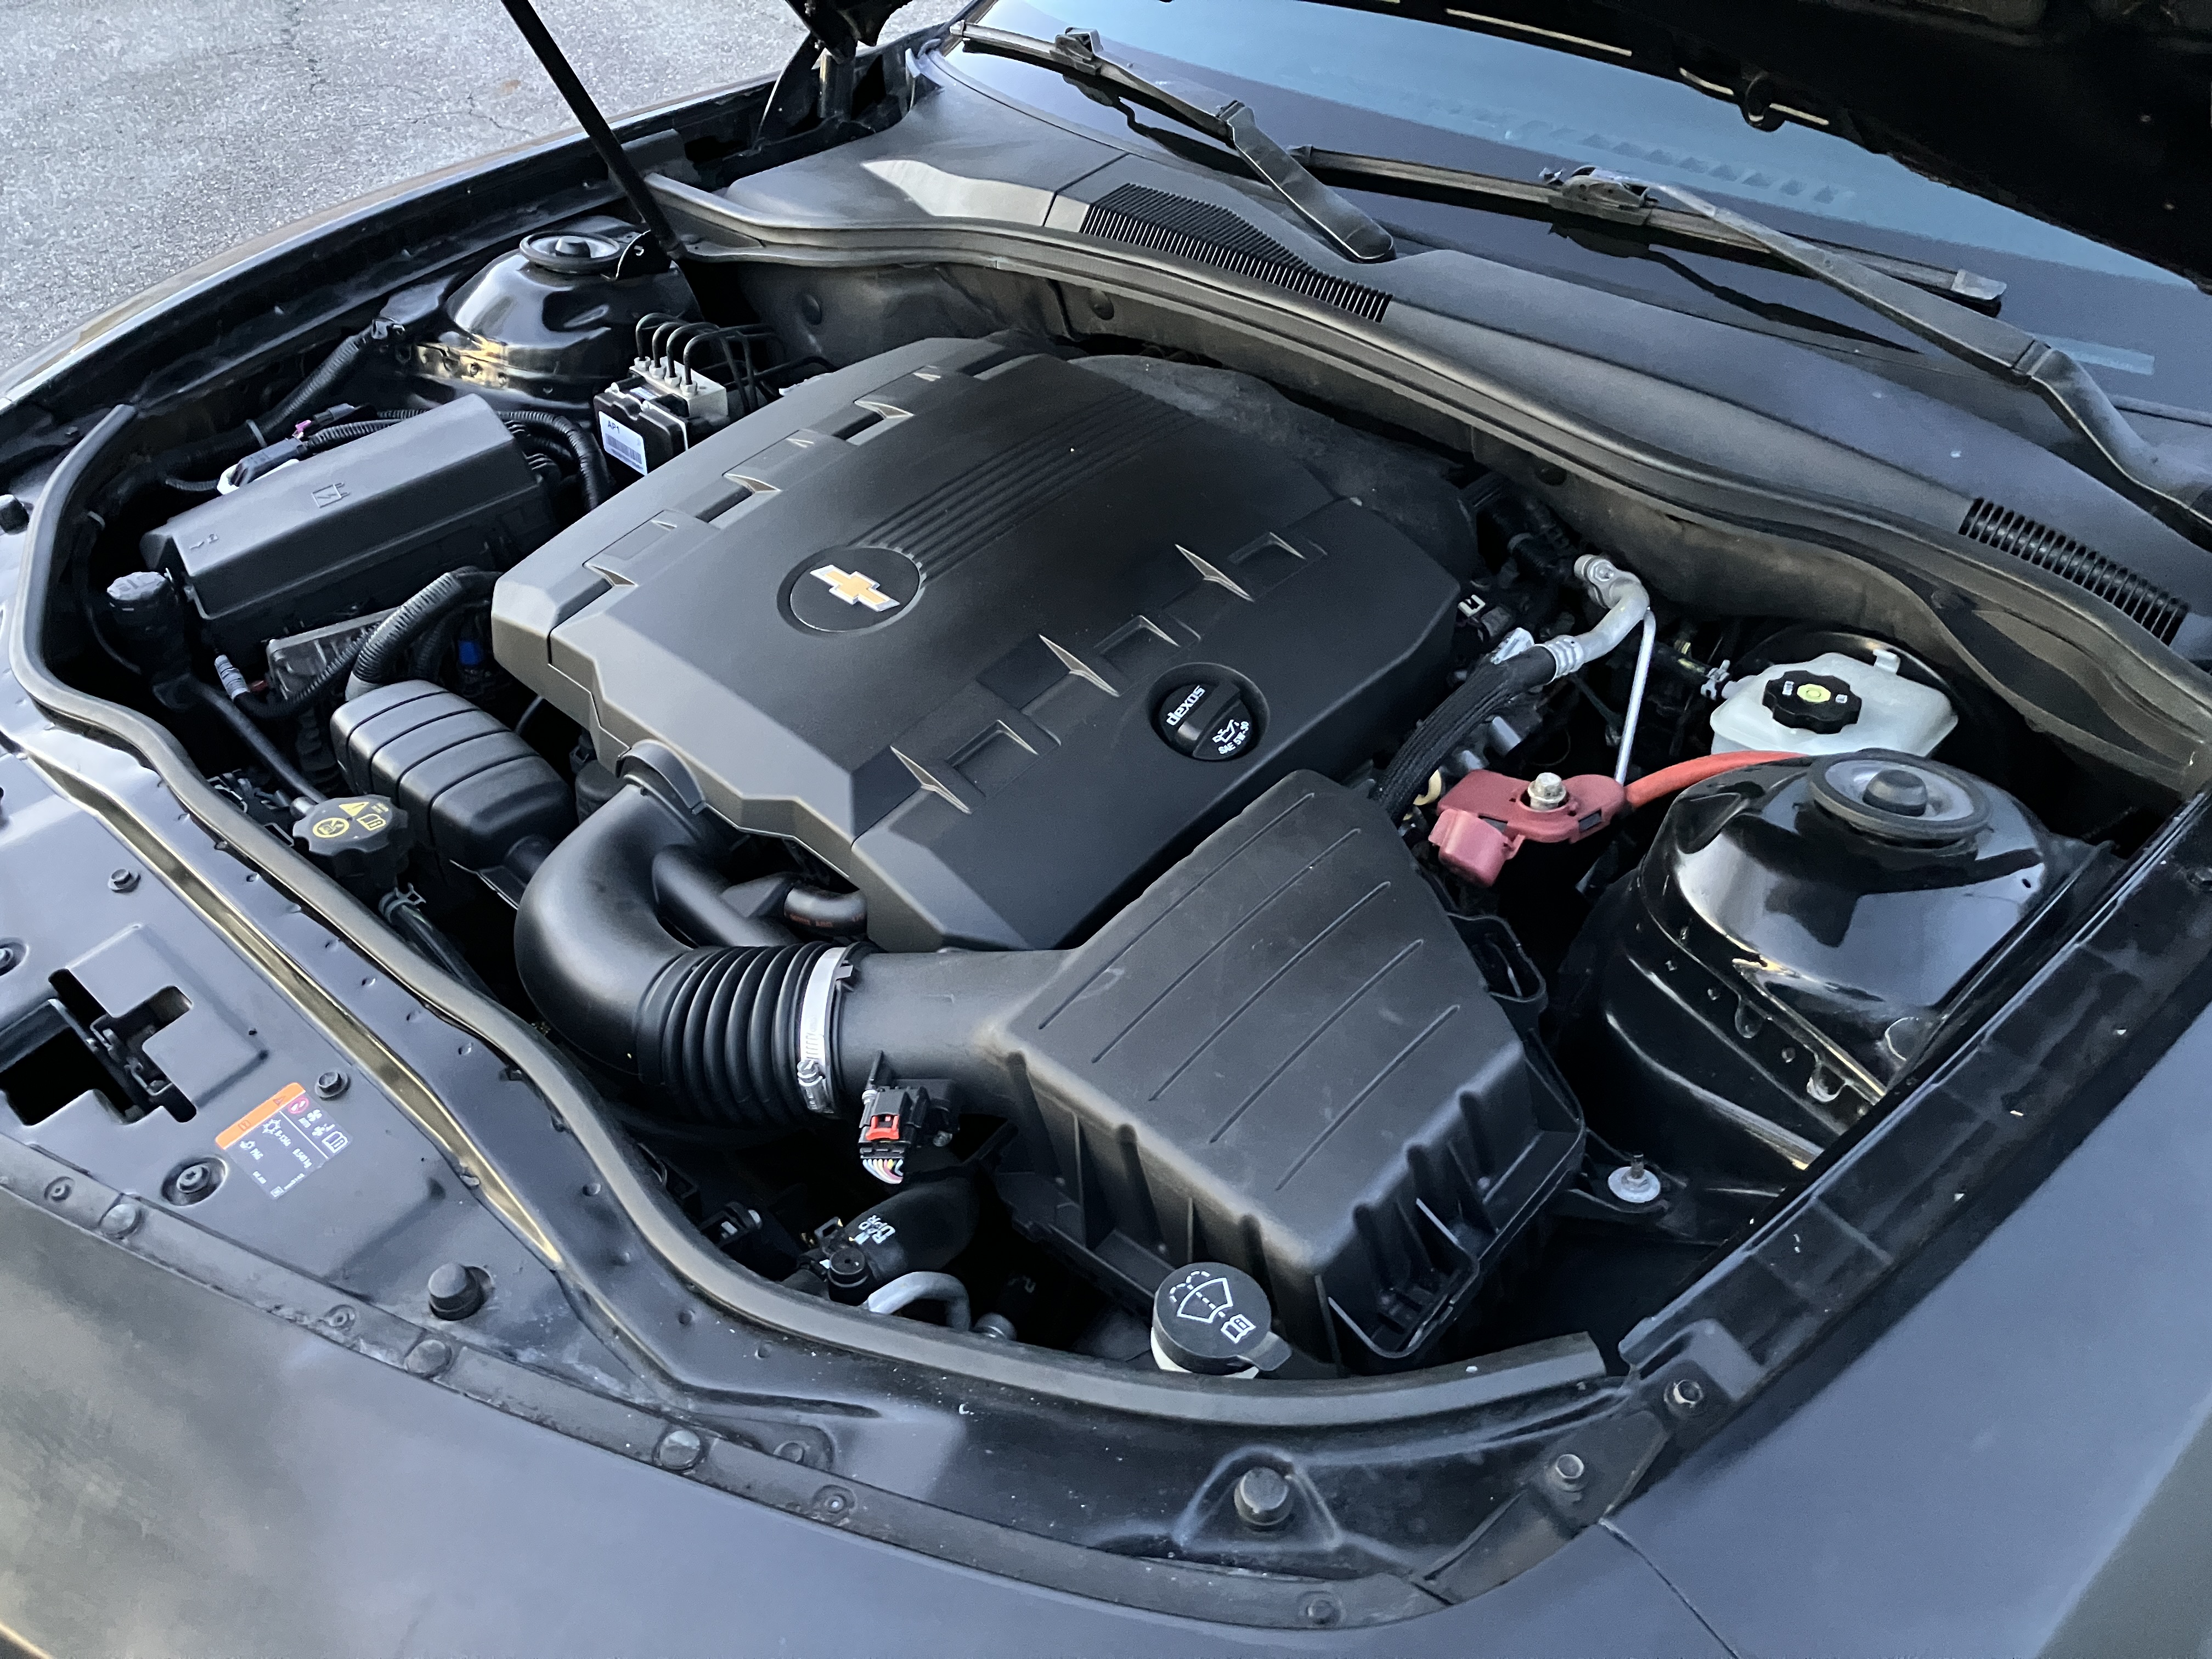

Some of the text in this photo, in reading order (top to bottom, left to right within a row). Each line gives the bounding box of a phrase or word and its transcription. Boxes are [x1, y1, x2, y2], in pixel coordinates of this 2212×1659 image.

[607, 420, 620, 434] AP1
[1166, 685, 1205, 725] dexos
[1218, 721, 1249, 754] SAE 5W-30
